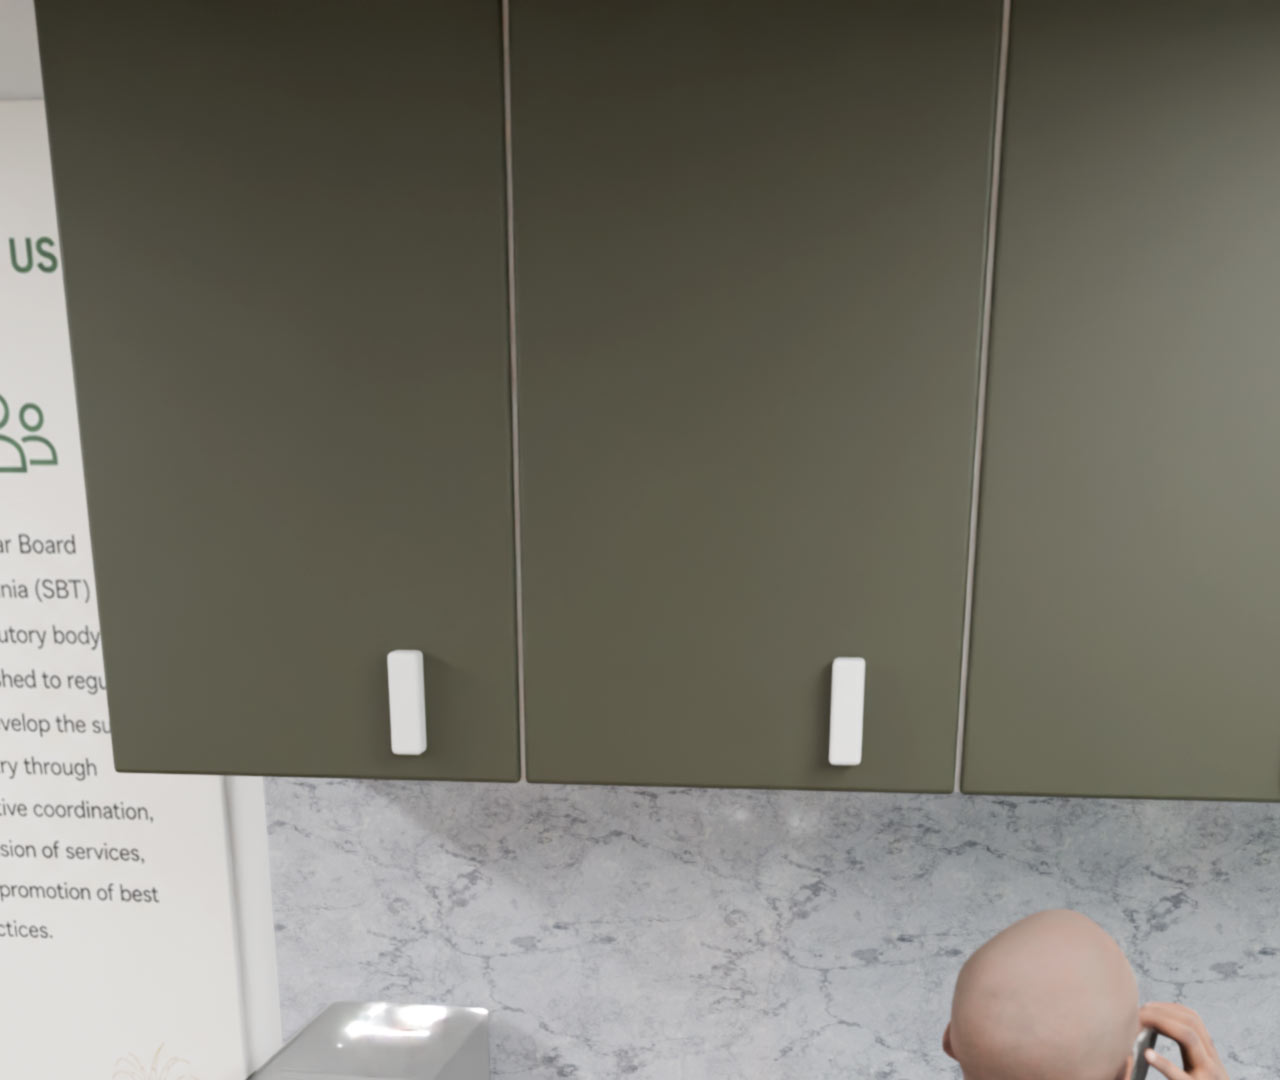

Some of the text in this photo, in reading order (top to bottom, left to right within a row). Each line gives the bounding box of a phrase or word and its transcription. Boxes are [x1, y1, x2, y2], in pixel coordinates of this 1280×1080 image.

[9, 237, 58, 273] US
[18, 534, 76, 554] Board
[35, 579, 90, 603] (SBT)
[53, 626, 100, 650] body
[42, 672, 62, 689] to
[55, 714, 86, 733] the
[24, 756, 97, 781] through
[33, 800, 154, 822] coordination,
[42, 841, 59, 859] of
[66, 843, 145, 863] services,
[0, 882, 91, 901] promotion
[97, 883, 114, 901] of
[120, 884, 159, 903] best
